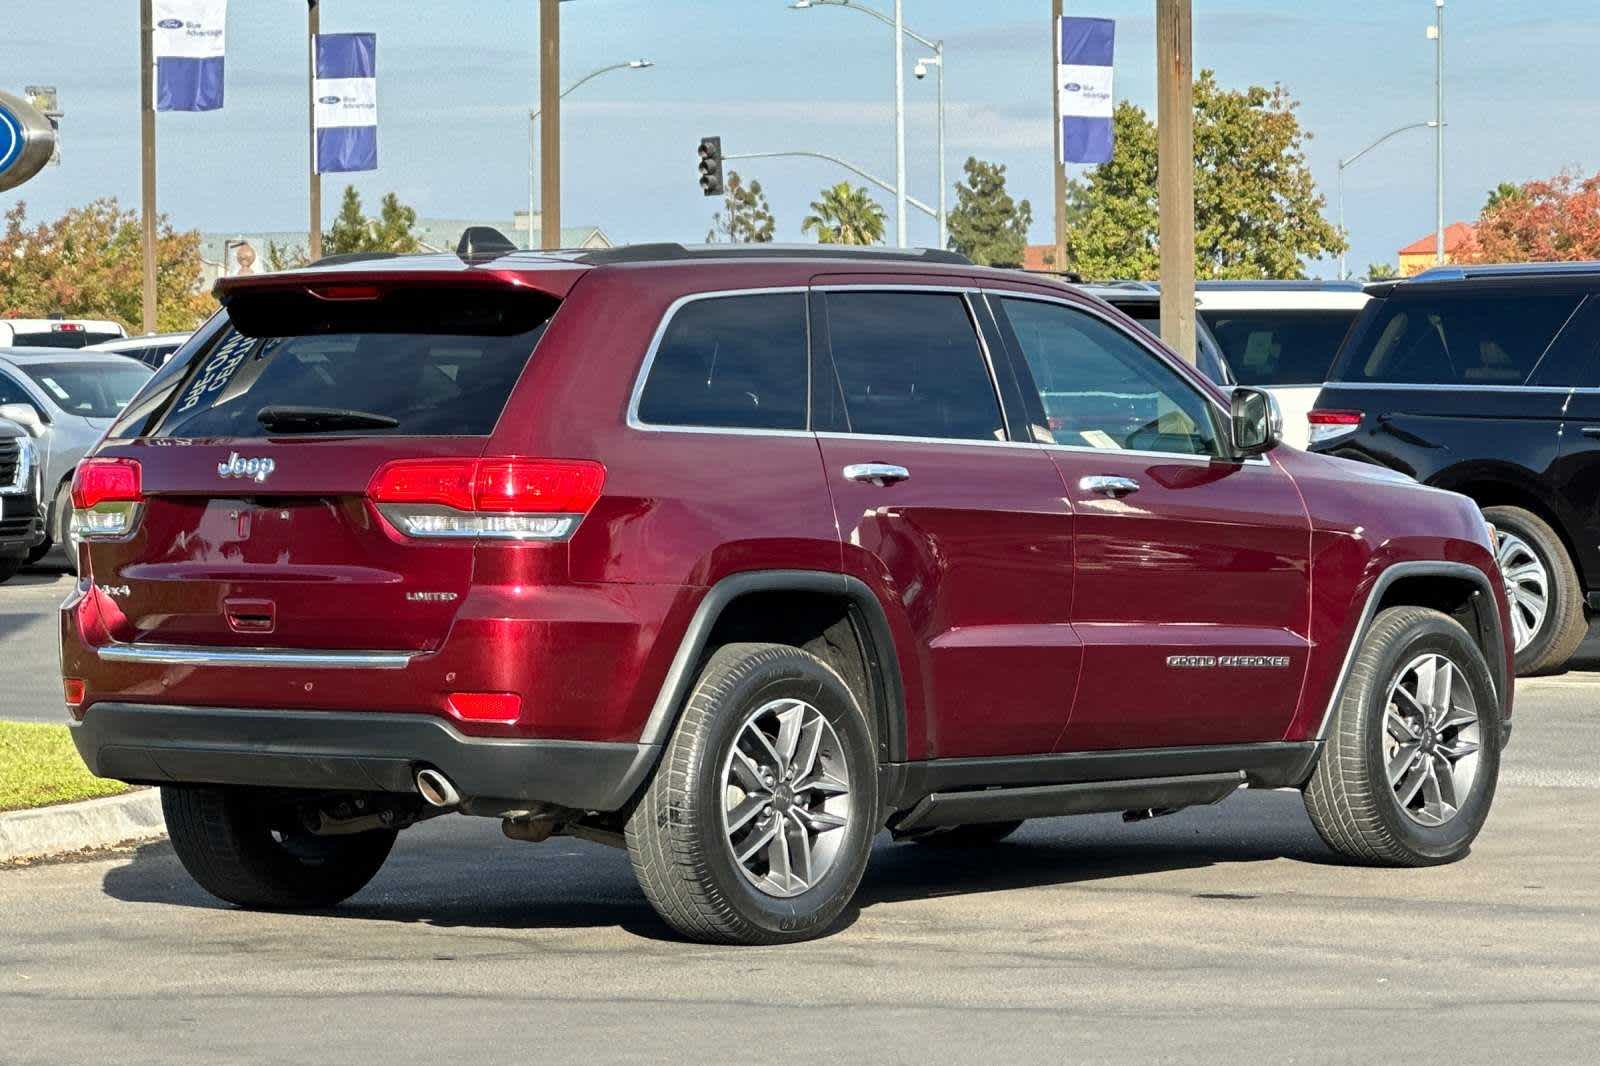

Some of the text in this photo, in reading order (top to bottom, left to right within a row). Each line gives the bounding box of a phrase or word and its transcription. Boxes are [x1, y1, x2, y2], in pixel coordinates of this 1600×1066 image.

[217, 451, 275, 482] Jeep
[406, 592, 458, 601] LIMITED
[1166, 656, 1290, 666] GRAND CHEROKEE
